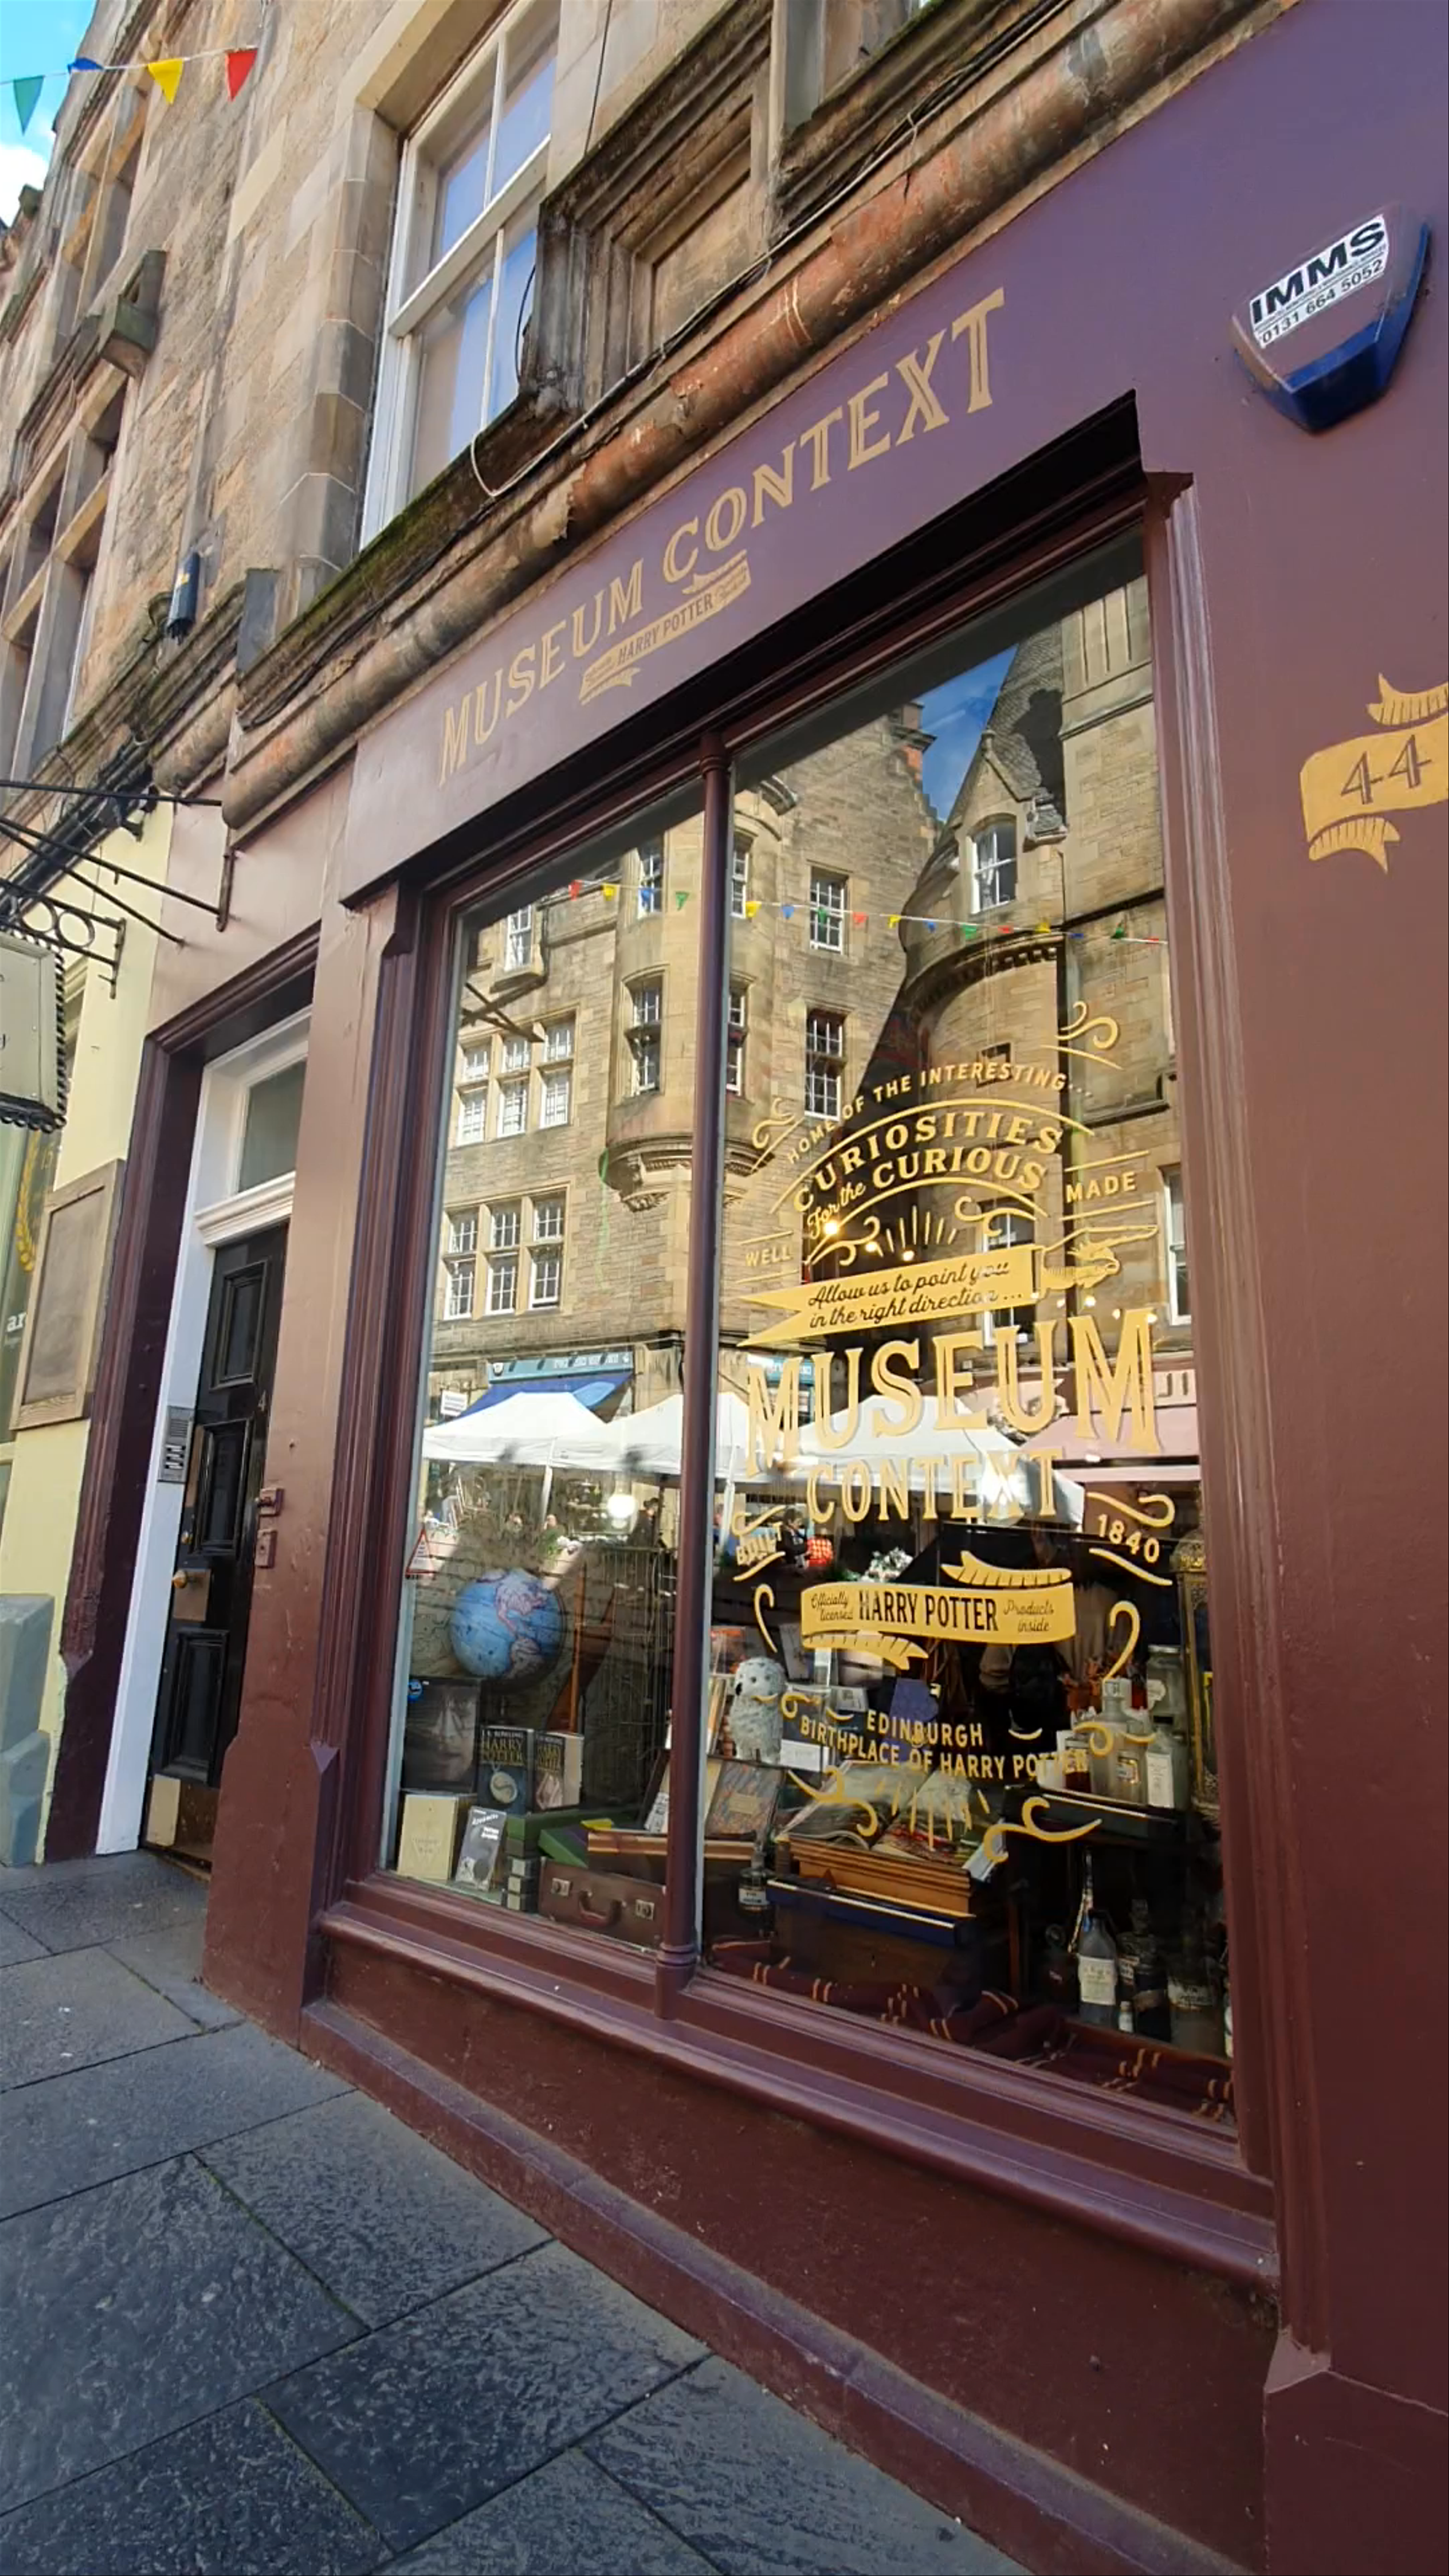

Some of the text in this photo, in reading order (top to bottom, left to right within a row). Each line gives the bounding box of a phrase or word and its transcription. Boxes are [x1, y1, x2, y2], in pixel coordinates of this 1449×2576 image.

[1251, 222, 1385, 324] IMMS
[1262, 312, 1299, 343] 0131
[1306, 288, 1335, 314] 664
[1341, 259, 1383, 291] 5052
[439, 288, 1004, 787] MUSEUM CONTEXT
[617, 593, 714, 666] HARRY POTTER
[1341, 734, 1432, 805] 44
[788, 1120, 835, 1164] HOME
[842, 1095, 864, 1120] OF
[874, 1075, 912, 1103] THE
[794, 1112, 1063, 1212] CURIOSITIES
[807, 1146, 1047, 1240] For the CURIOUS
[1066, 1171, 1137, 1203] MADE
[745, 1245, 792, 1267] WELL
[808, 1261, 1009, 1309] Allow us to point you
[810, 1313, 827, 1328] in
[829, 1306, 857, 1326] the
[860, 1297, 907, 1324] right
[746, 1308, 1161, 1478] MUSEUM
[807, 1448, 1062, 1524] CONTEXT
[1098, 1513, 1160, 1563] 1840
[811, 1591, 849, 1610] Officially
[859, 1590, 998, 1631] HARRY POTTER
[1003, 1598, 1055, 1615] Products
[1017, 1619, 1050, 1632] inside
[800, 1715, 900, 1766] BIRTHPLACE
[909, 1748, 933, 1773] OF
[940, 1752, 1006, 1780] HARRY
[1012, 1749, 1089, 1779] POTTER
[867, 1709, 983, 1748] EDINBURGH
